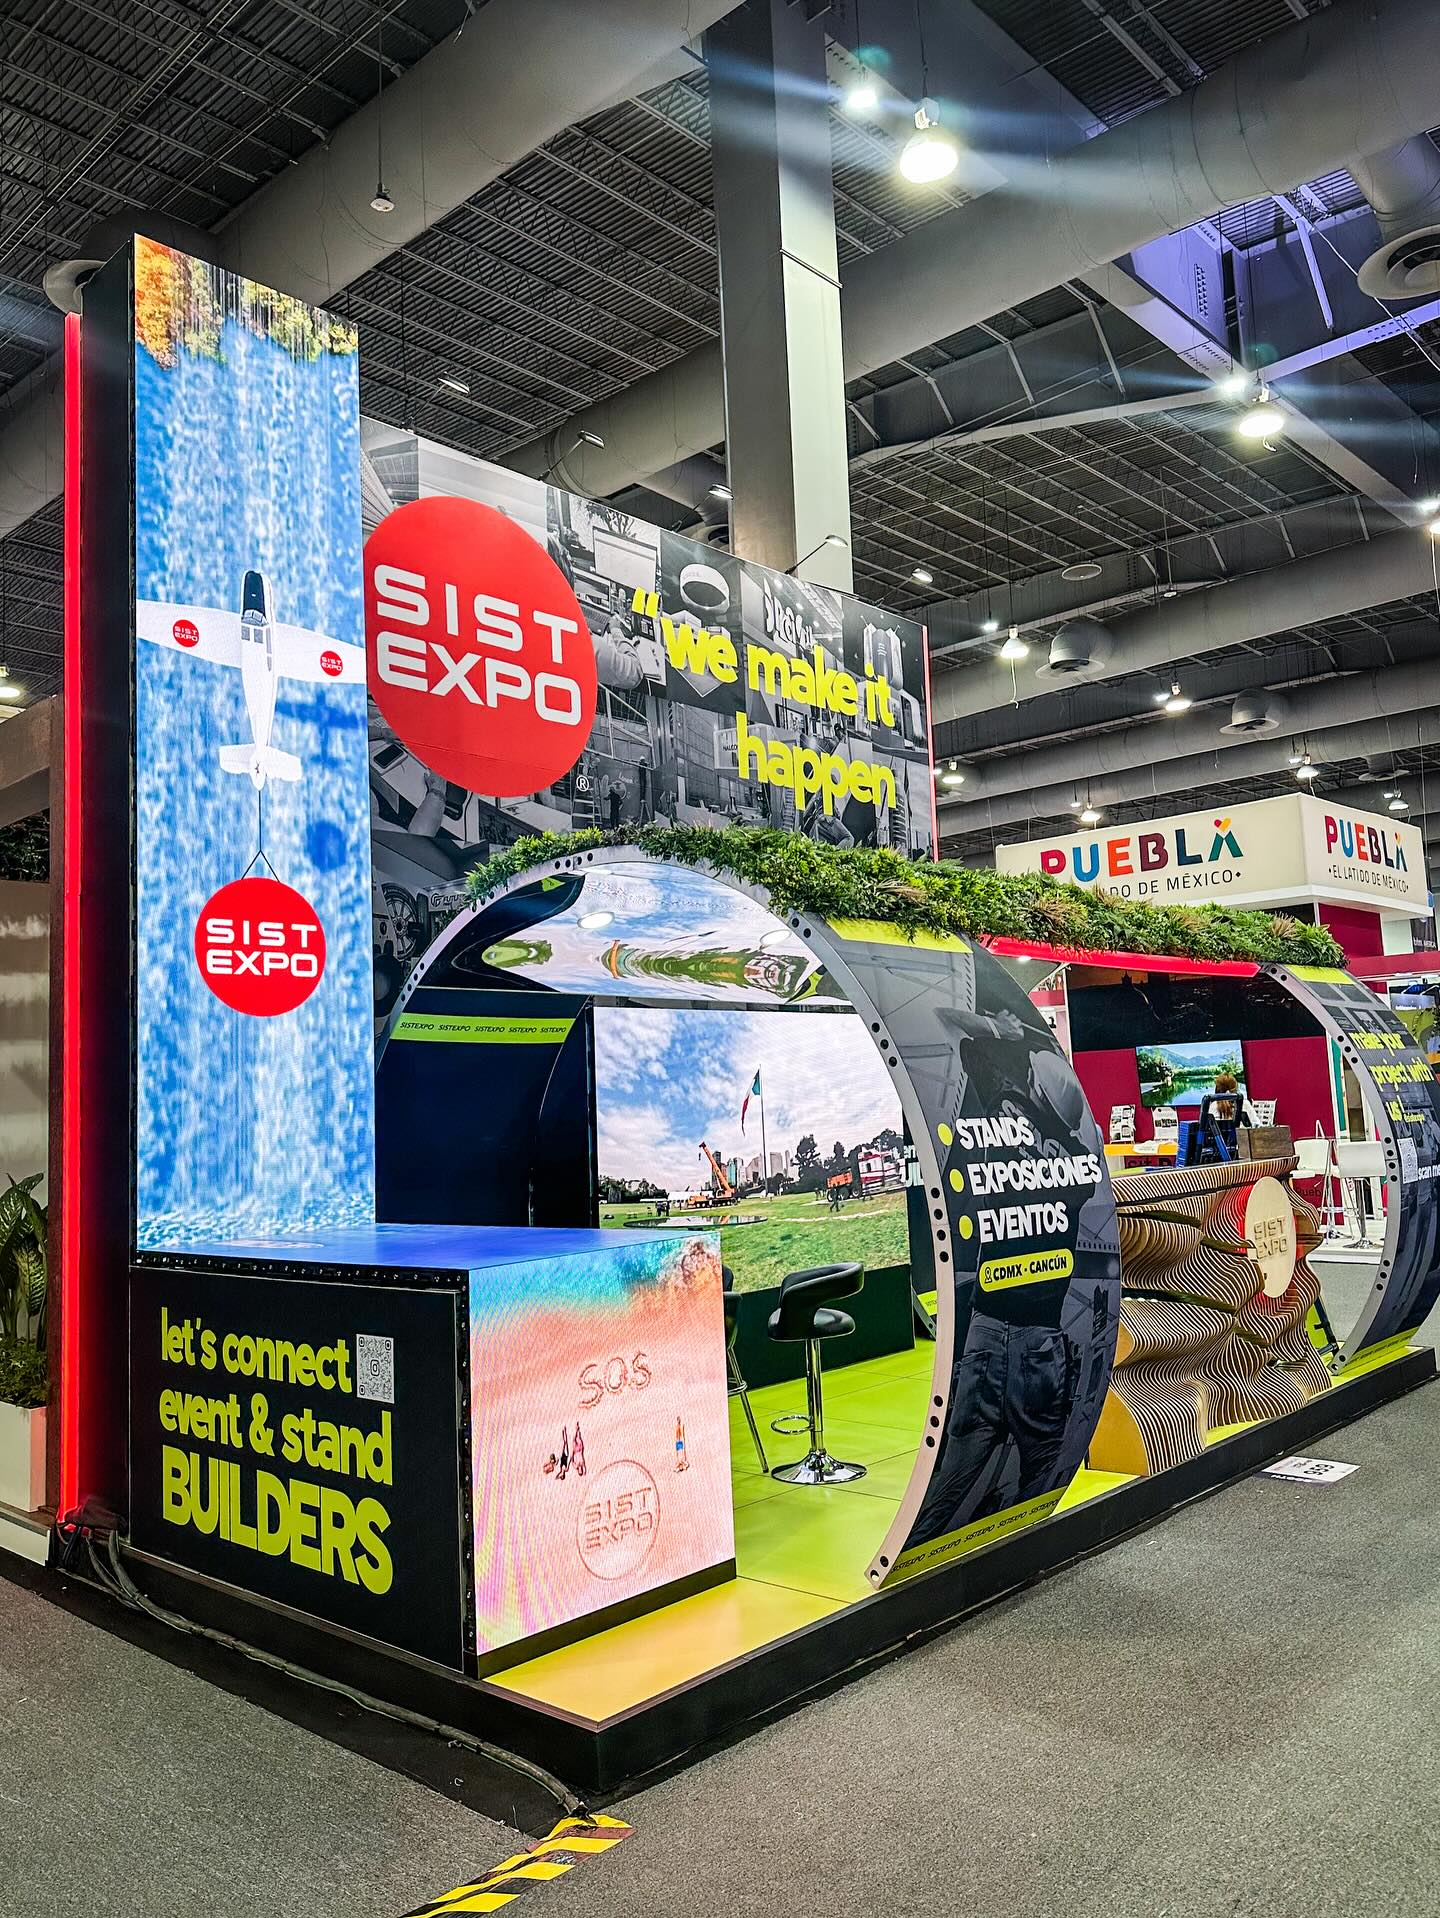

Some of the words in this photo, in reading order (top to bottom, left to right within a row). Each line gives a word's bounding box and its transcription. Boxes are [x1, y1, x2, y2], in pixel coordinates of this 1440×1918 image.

[374, 563, 578, 664] SIST
[376, 631, 581, 726] EXPO
[747, 644, 858, 716] make
[864, 662, 895, 727] it
[736, 711, 896, 816] happen
[1041, 816, 1243, 882] PUEBLA
[1325, 815, 1408, 872] PUEBLA
[1138, 880, 1159, 895] DE
[1166, 869, 1233, 891] MÉXICO
[1333, 865, 1342, 879] EL
[1344, 866, 1369, 883] LATIDO
[1372, 872, 1381, 886] DE
[1382, 874, 1406, 893] MÉXICO
[206, 918, 317, 948] SIST
[206, 949, 318, 978] EXPO
[400, 1021, 434, 1030] SISTEXPO
[438, 1024, 471, 1032] SISTEXPO
[474, 1025, 505, 1033] SISTEXPO
[508, 1026, 537, 1034] SISTEXPO
[1377, 1032, 1406, 1056] your
[1369, 1058, 1412, 1092] project
[1406, 1056, 1434, 1082] with
[955, 1116, 1035, 1150] STANDS
[967, 1153, 1103, 1196] EXPOSICIONES
[977, 1201, 1069, 1243] EVENTOS
[993, 1264, 1022, 1282] CDMX
[1029, 1254, 1067, 1275] CANCÚN
[222, 1332, 352, 1393] connect
[578, 1350, 652, 1409] SOS
[159, 1388, 243, 1449] event
[249, 1392, 275, 1457] &
[281, 1408, 393, 1486] stand
[162, 1444, 394, 1595] BUILDERS
[585, 1487, 653, 1525] SIST
[585, 1511, 653, 1554] EXPO
